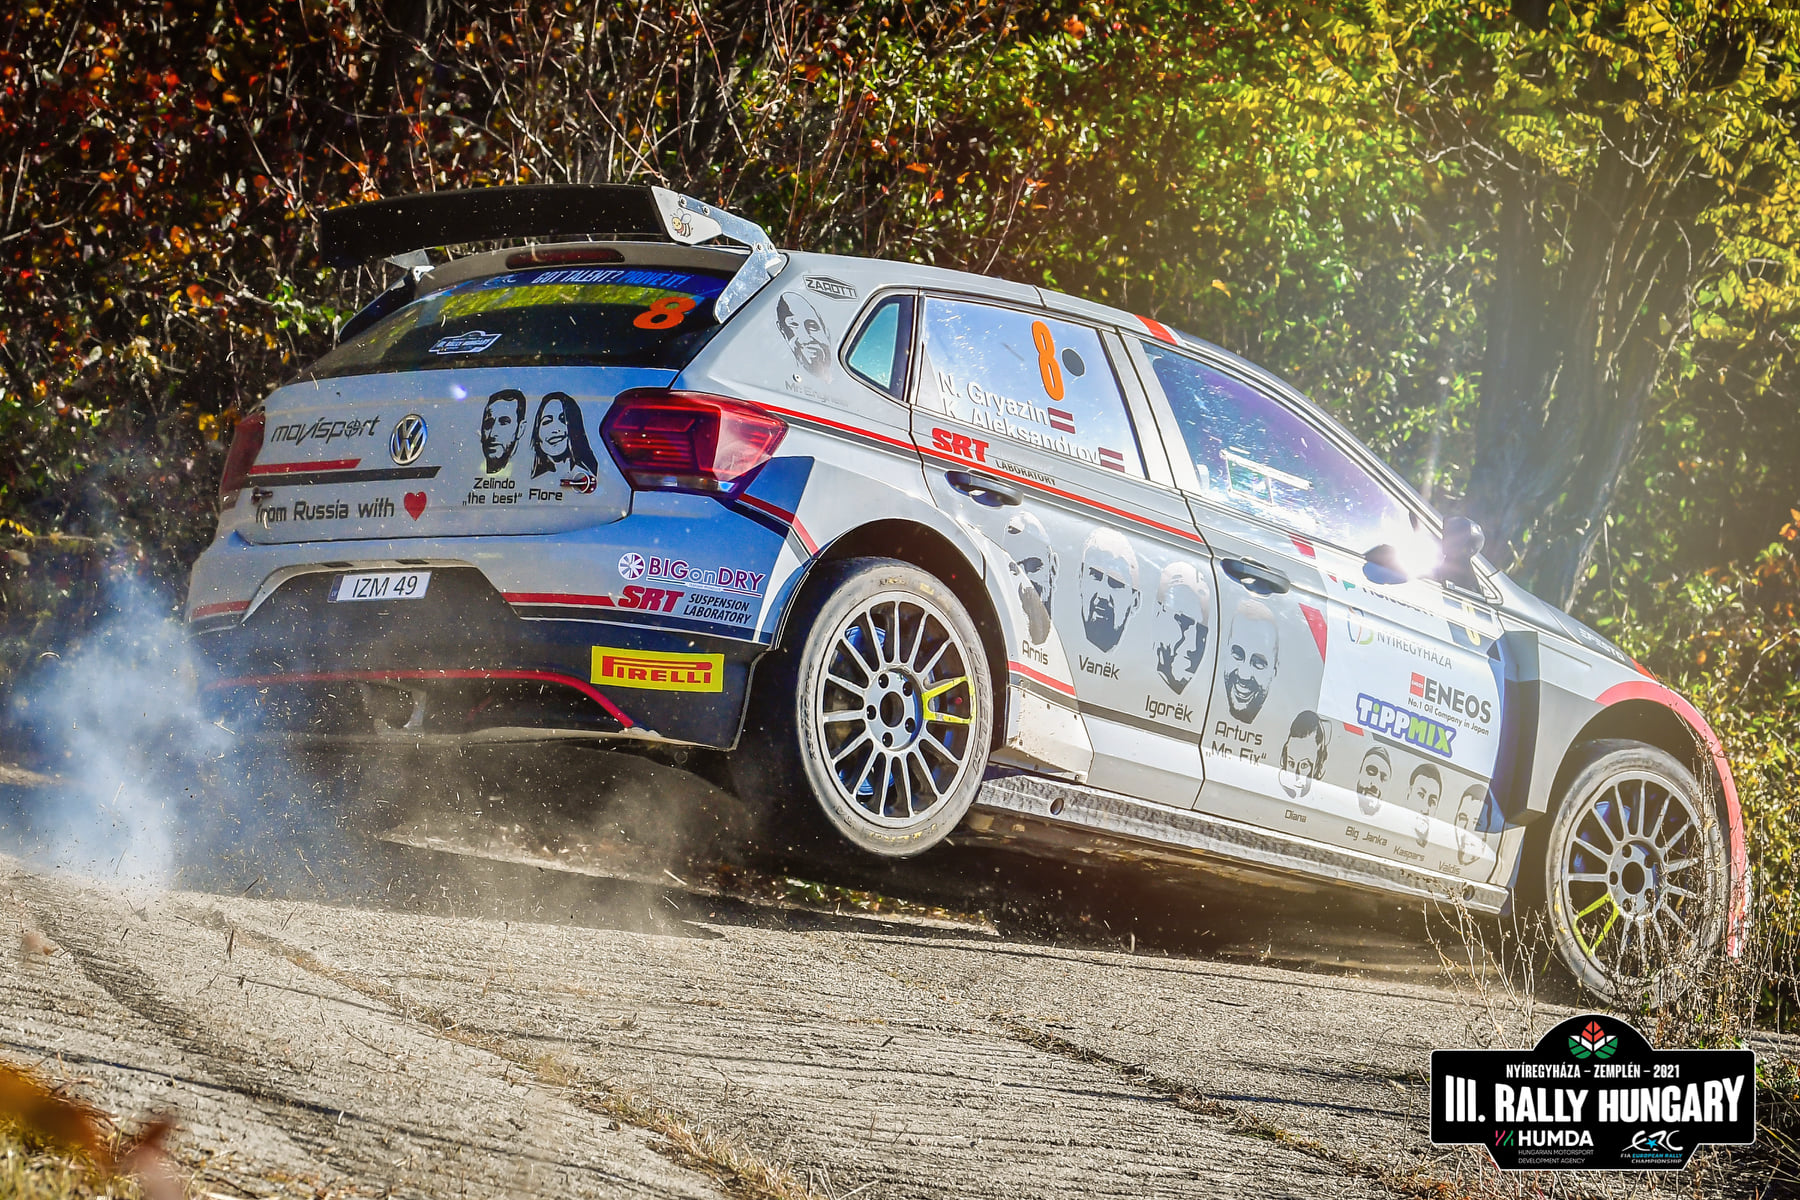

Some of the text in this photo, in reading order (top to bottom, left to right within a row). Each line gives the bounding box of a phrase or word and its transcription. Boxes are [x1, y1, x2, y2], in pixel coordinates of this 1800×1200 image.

[531, 270, 567, 284] GOT
[560, 270, 625, 284] TALENT?
[805, 278, 858, 299] ZAROTTI
[632, 296, 697, 330] 8
[1031, 319, 1065, 402] 8
[938, 370, 1050, 425] N. Gryazin
[931, 427, 990, 463] SRT
[972, 408, 1102, 465] Aleksandrov
[473, 477, 516, 489] Zelindo
[995, 459, 1056, 486] LABORATORY
[528, 488, 563, 501] Flore
[293, 499, 349, 521] Russia
[358, 497, 395, 519] with
[352, 575, 418, 598] IZM 49
[648, 555, 767, 591] BIGonDRY
[617, 585, 685, 613] SRT
[688, 593, 750, 612] SUSPENSION
[683, 604, 752, 625] LABORATORY
[1021, 639, 1049, 666] Arnis
[602, 655, 713, 684] PIRELLI
[1077, 654, 1121, 681] Vanëk
[1144, 694, 1194, 724] Igorëk
[1424, 677, 1492, 724] ENEOS
[1214, 721, 1263, 746] Arturs
[1424, 703, 1434, 714] Oil
[1434, 708, 1463, 727] Company
[1463, 718, 1471, 729] in
[1471, 722, 1490, 737] Japan
[1345, 825, 1388, 847] Big Janka
[1393, 845, 1425, 861] Kaspars
